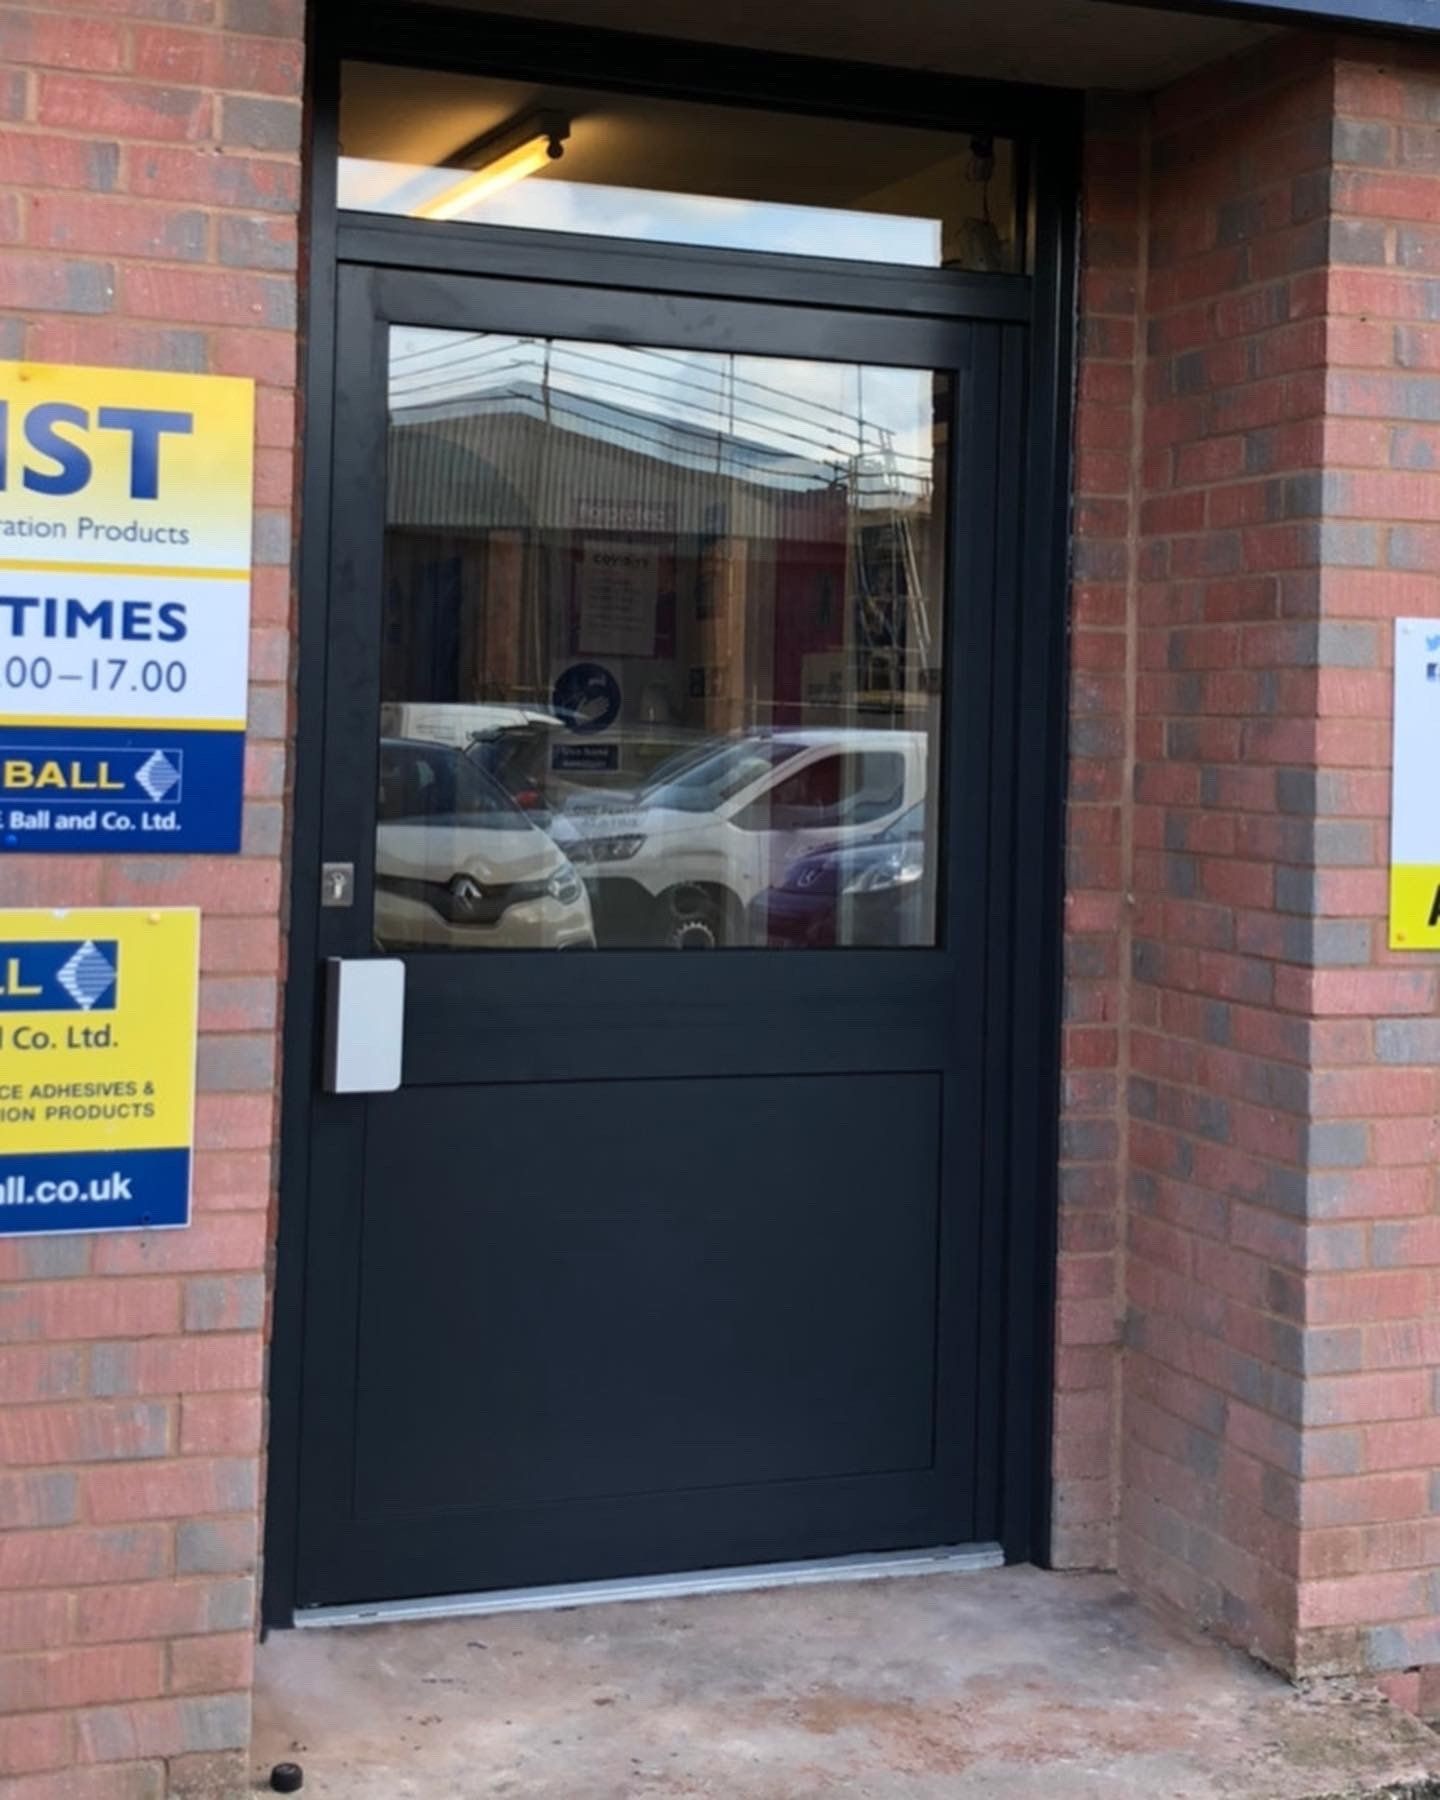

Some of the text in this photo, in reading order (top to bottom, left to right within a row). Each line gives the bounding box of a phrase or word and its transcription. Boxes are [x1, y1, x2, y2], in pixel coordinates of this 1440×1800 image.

[0, 402, 193, 500] ST
[78, 516, 190, 545] Products
[0, 596, 188, 642] TIMES
[4, 655, 187, 692] 00–17.00
[4, 760, 125, 789] BALL
[10, 809, 50, 830] Ball
[55, 810, 97, 830] and
[101, 811, 136, 831] Co.
[141, 811, 181, 831] Ltd.
[0, 958, 42, 995] L
[12, 1026, 57, 1049] Co.
[67, 1024, 118, 1048] Ltd.
[30, 1081, 137, 1099] ADHESIVES
[143, 1081, 155, 1096] &
[45, 1102, 155, 1121] PRODUCTS
